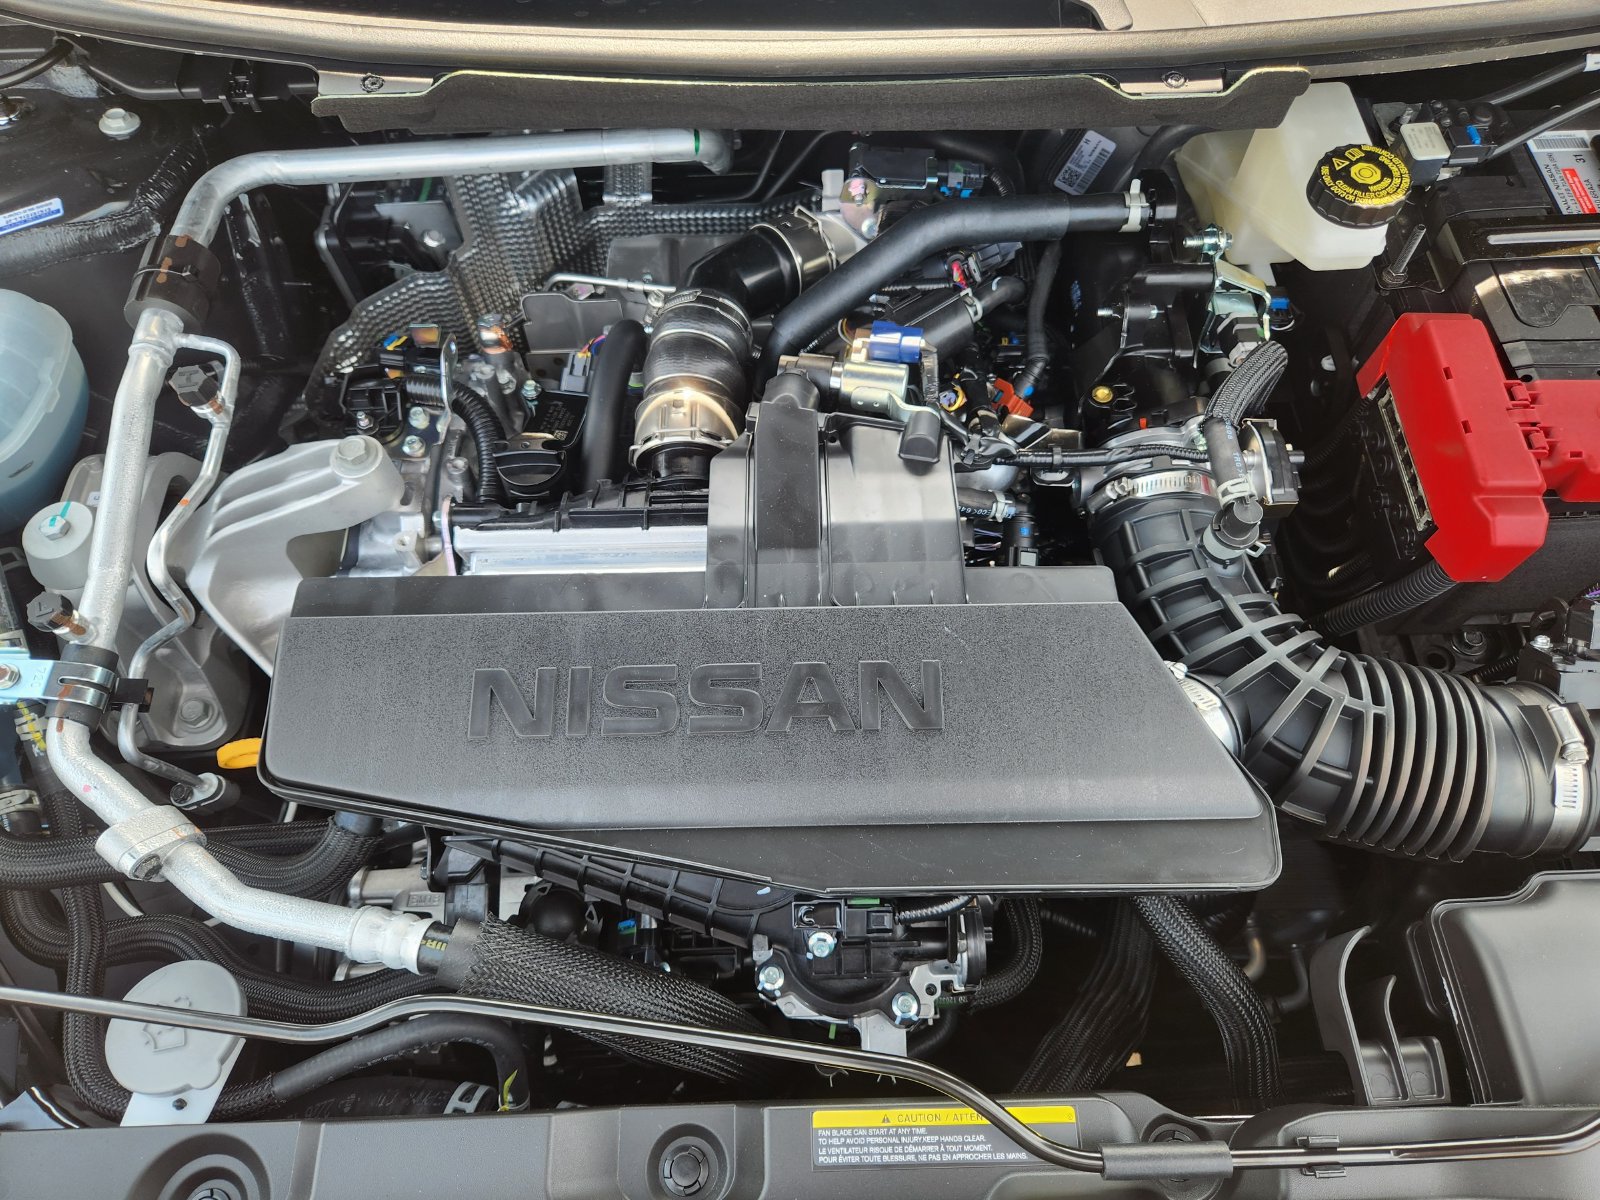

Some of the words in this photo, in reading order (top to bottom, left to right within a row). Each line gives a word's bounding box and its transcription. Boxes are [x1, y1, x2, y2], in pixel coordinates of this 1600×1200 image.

[1361, 144, 1394, 160] CONTAINER
[1573, 154, 1586, 163] 31
[1320, 165, 1329, 175] USE
[1391, 157, 1408, 174] SEALED
[1322, 175, 1335, 187] ONLY
[1544, 164, 1560, 190] NISSAN
[1330, 185, 1347, 198] DOT3
[1335, 180, 1354, 194] CLEAN
[1353, 190, 1375, 199] FILLER
[1375, 189, 1388, 198] CAP
[1344, 193, 1355, 202] OR
[467, 658, 945, 740] NISSAN
[897, 1113, 941, 1123] CAUTION
[953, 1112, 983, 1122] ATTEN
[853, 1128, 867, 1136] CAN
[912, 1127, 928, 1135] TIME.
[818, 1137, 828, 1145] TO
[828, 1137, 845, 1145] HELP
[846, 1137, 865, 1145] AVOID
[866, 1136, 900, 1144] PERSONAL
[940, 1135, 962, 1143] HANDS
[963, 1134, 986, 1142] CLEAR.
[818, 1147, 827, 1155] LE
[827, 1146, 869, 1155] VENTILATEUR
[869, 1146, 893, 1154] RISQUE
[904, 1144, 940, 1153] DÉMARRER
[940, 1143, 945, 1152] À
[963, 1144, 993, 1152] MOMENT.
[818, 1156, 838, 1164] POUR
[839, 1154, 860, 1163] ÉVITER
[861, 1155, 881, 1163] TOUTE
[882, 1154, 917, 1163] BLESSURE,
[918, 1154, 927, 1162] NE
[942, 1153, 951, 1161] EN
[952, 1153, 992, 1161] APPROCHER
[992, 1152, 1005, 1160] LES
[1006, 1152, 1029, 1160] MAINS.
